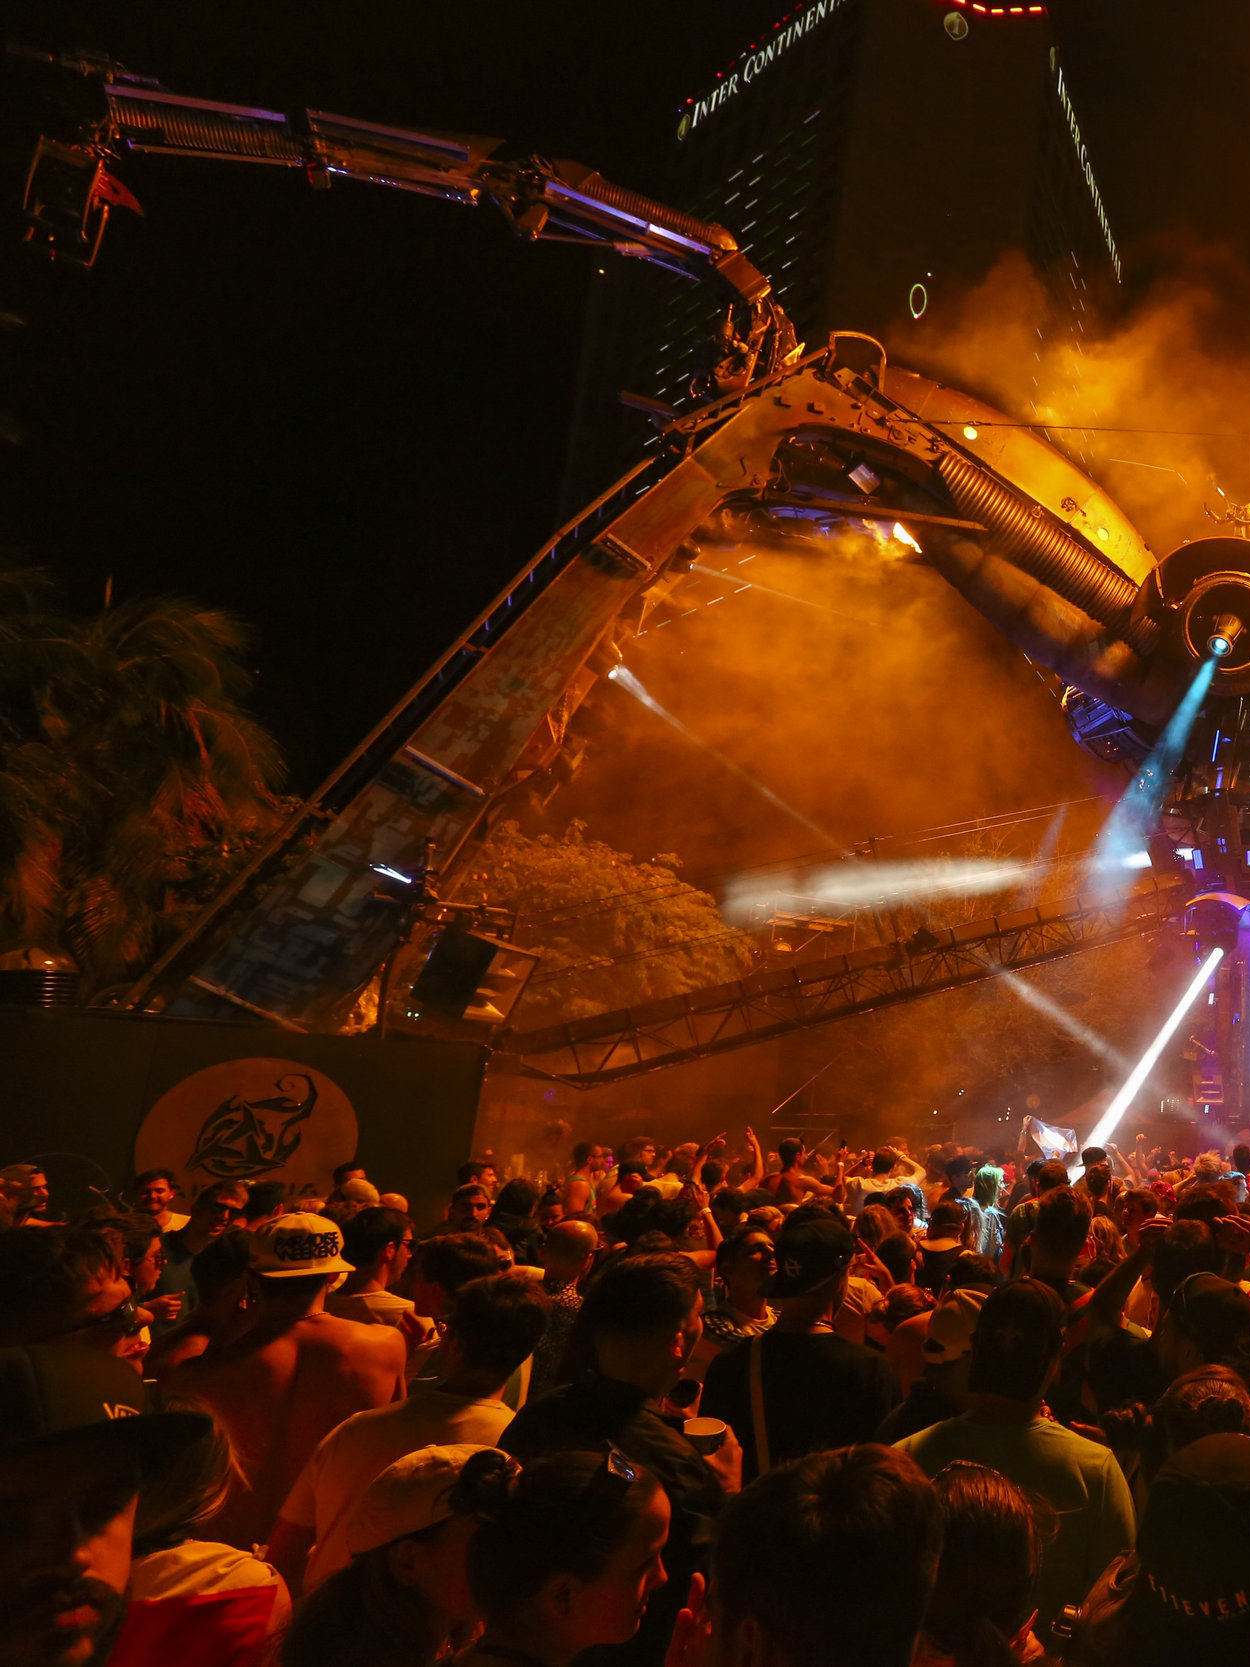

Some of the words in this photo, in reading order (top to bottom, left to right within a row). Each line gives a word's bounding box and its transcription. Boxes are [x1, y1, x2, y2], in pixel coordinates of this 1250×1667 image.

[692, 73, 739, 128] INTER
[743, 0, 846, 83] CONTINEN
[1058, 66, 1080, 160] INTER
[1081, 144, 1122, 284] CONTINENTAL
[273, 1244, 339, 1262] WEEKEND
